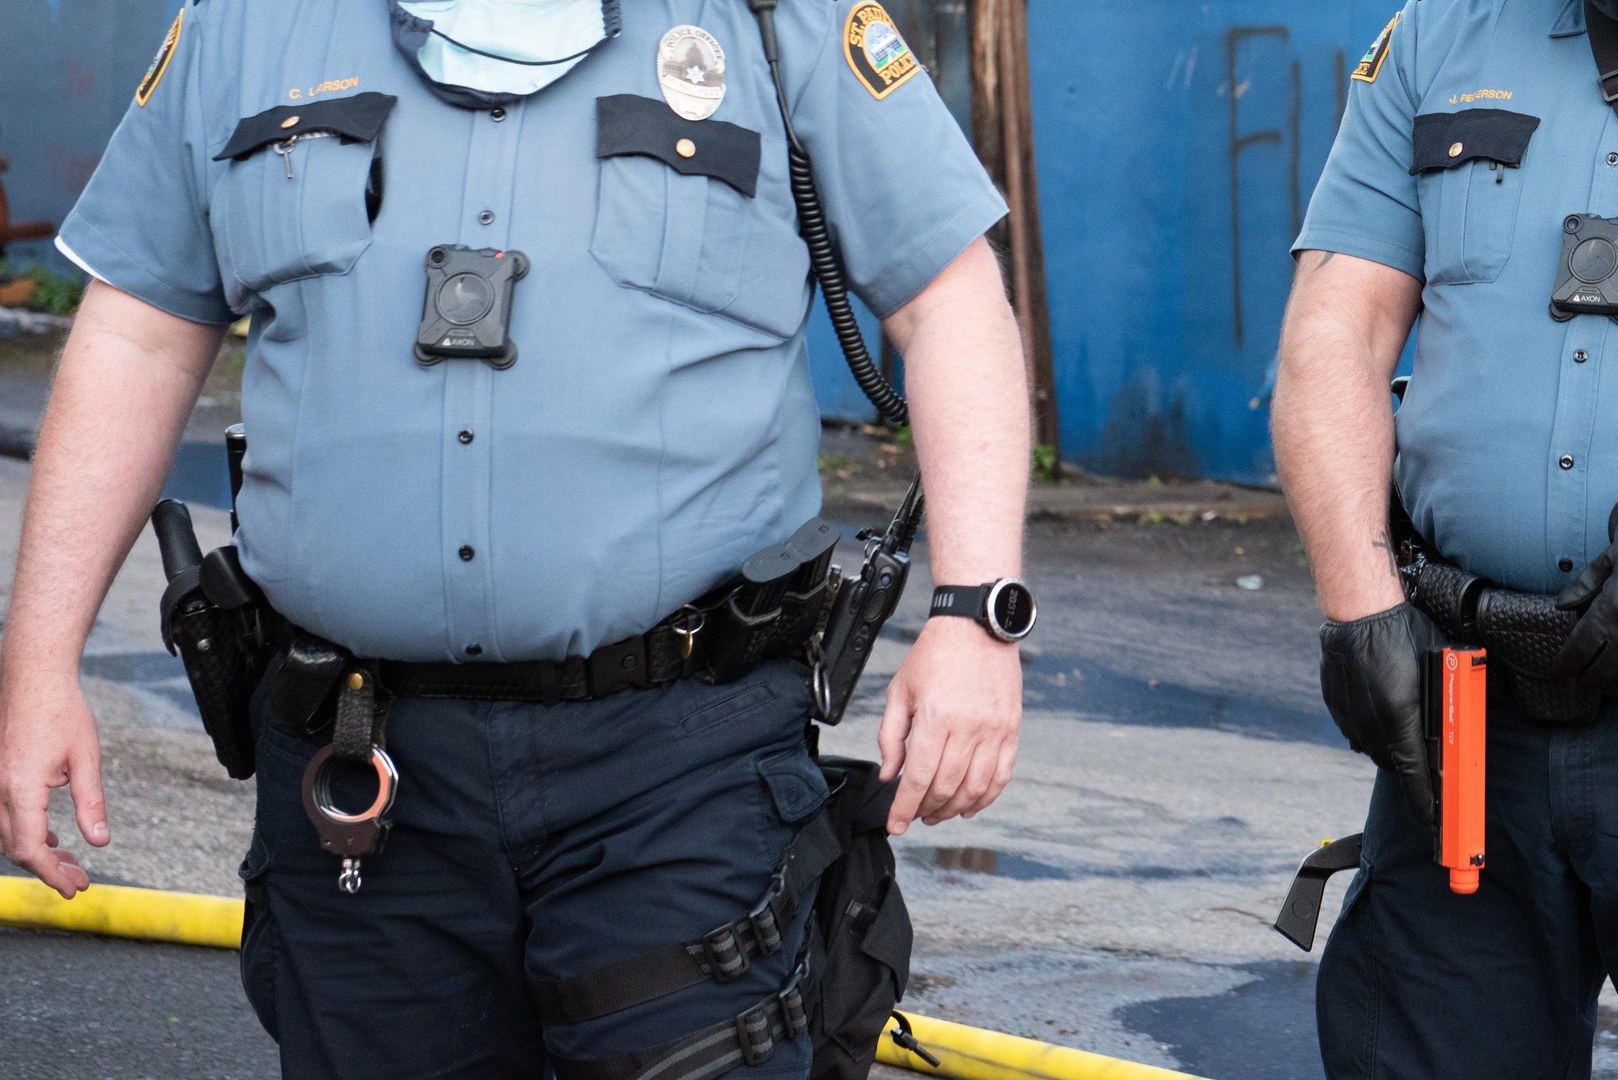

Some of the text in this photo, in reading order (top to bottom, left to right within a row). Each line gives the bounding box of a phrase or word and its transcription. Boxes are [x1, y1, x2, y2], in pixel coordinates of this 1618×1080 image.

[850, 21, 867, 48] ST.
[288, 76, 359, 100] C. LARSON
